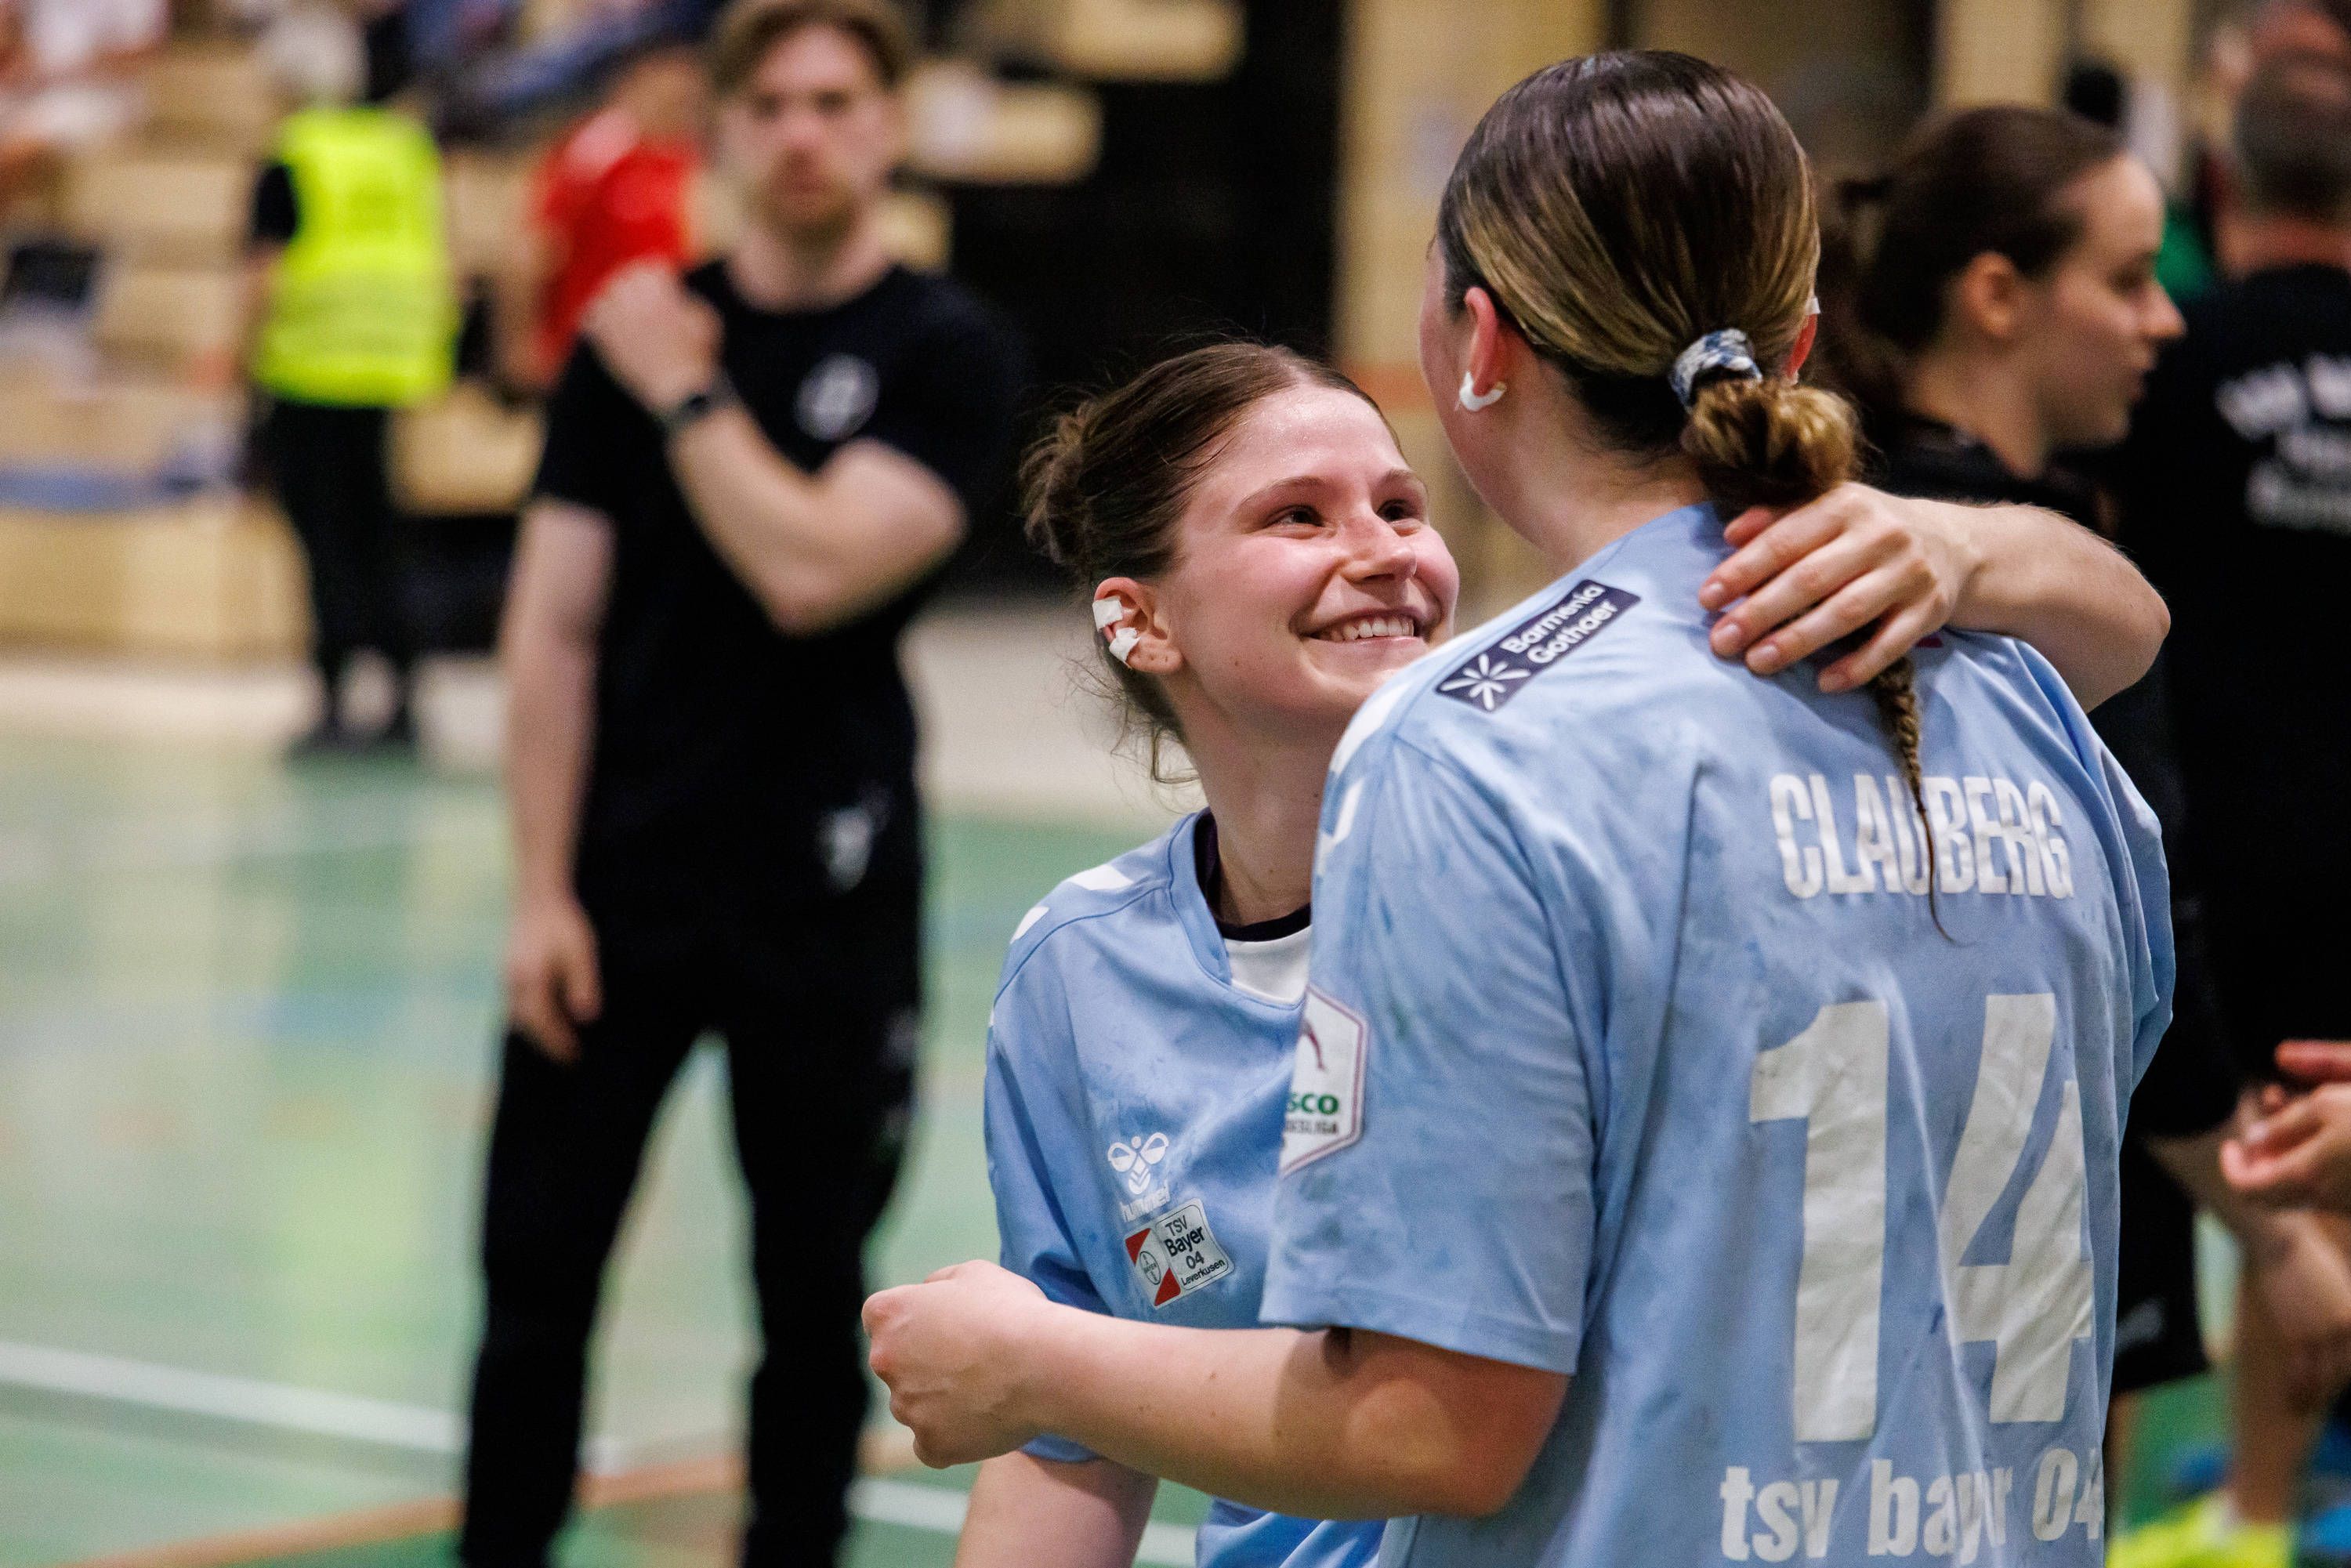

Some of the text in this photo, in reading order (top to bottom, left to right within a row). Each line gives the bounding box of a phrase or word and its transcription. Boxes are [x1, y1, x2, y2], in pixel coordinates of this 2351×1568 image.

[1500, 585, 1606, 654] Barmenia
[1527, 600, 1618, 664] Gothaer
[1769, 773, 2074, 900] CLAUBERG
[1164, 1226, 1205, 1257] Bayer
[1165, 1215, 1188, 1237] TSV
[1749, 992, 2092, 1442] 14
[1180, 1258, 1226, 1286] Leverkusen
[1186, 1251, 1204, 1269] 04
[1720, 1466, 1839, 1563] tsv
[1867, 1458, 2014, 1566] bayr
